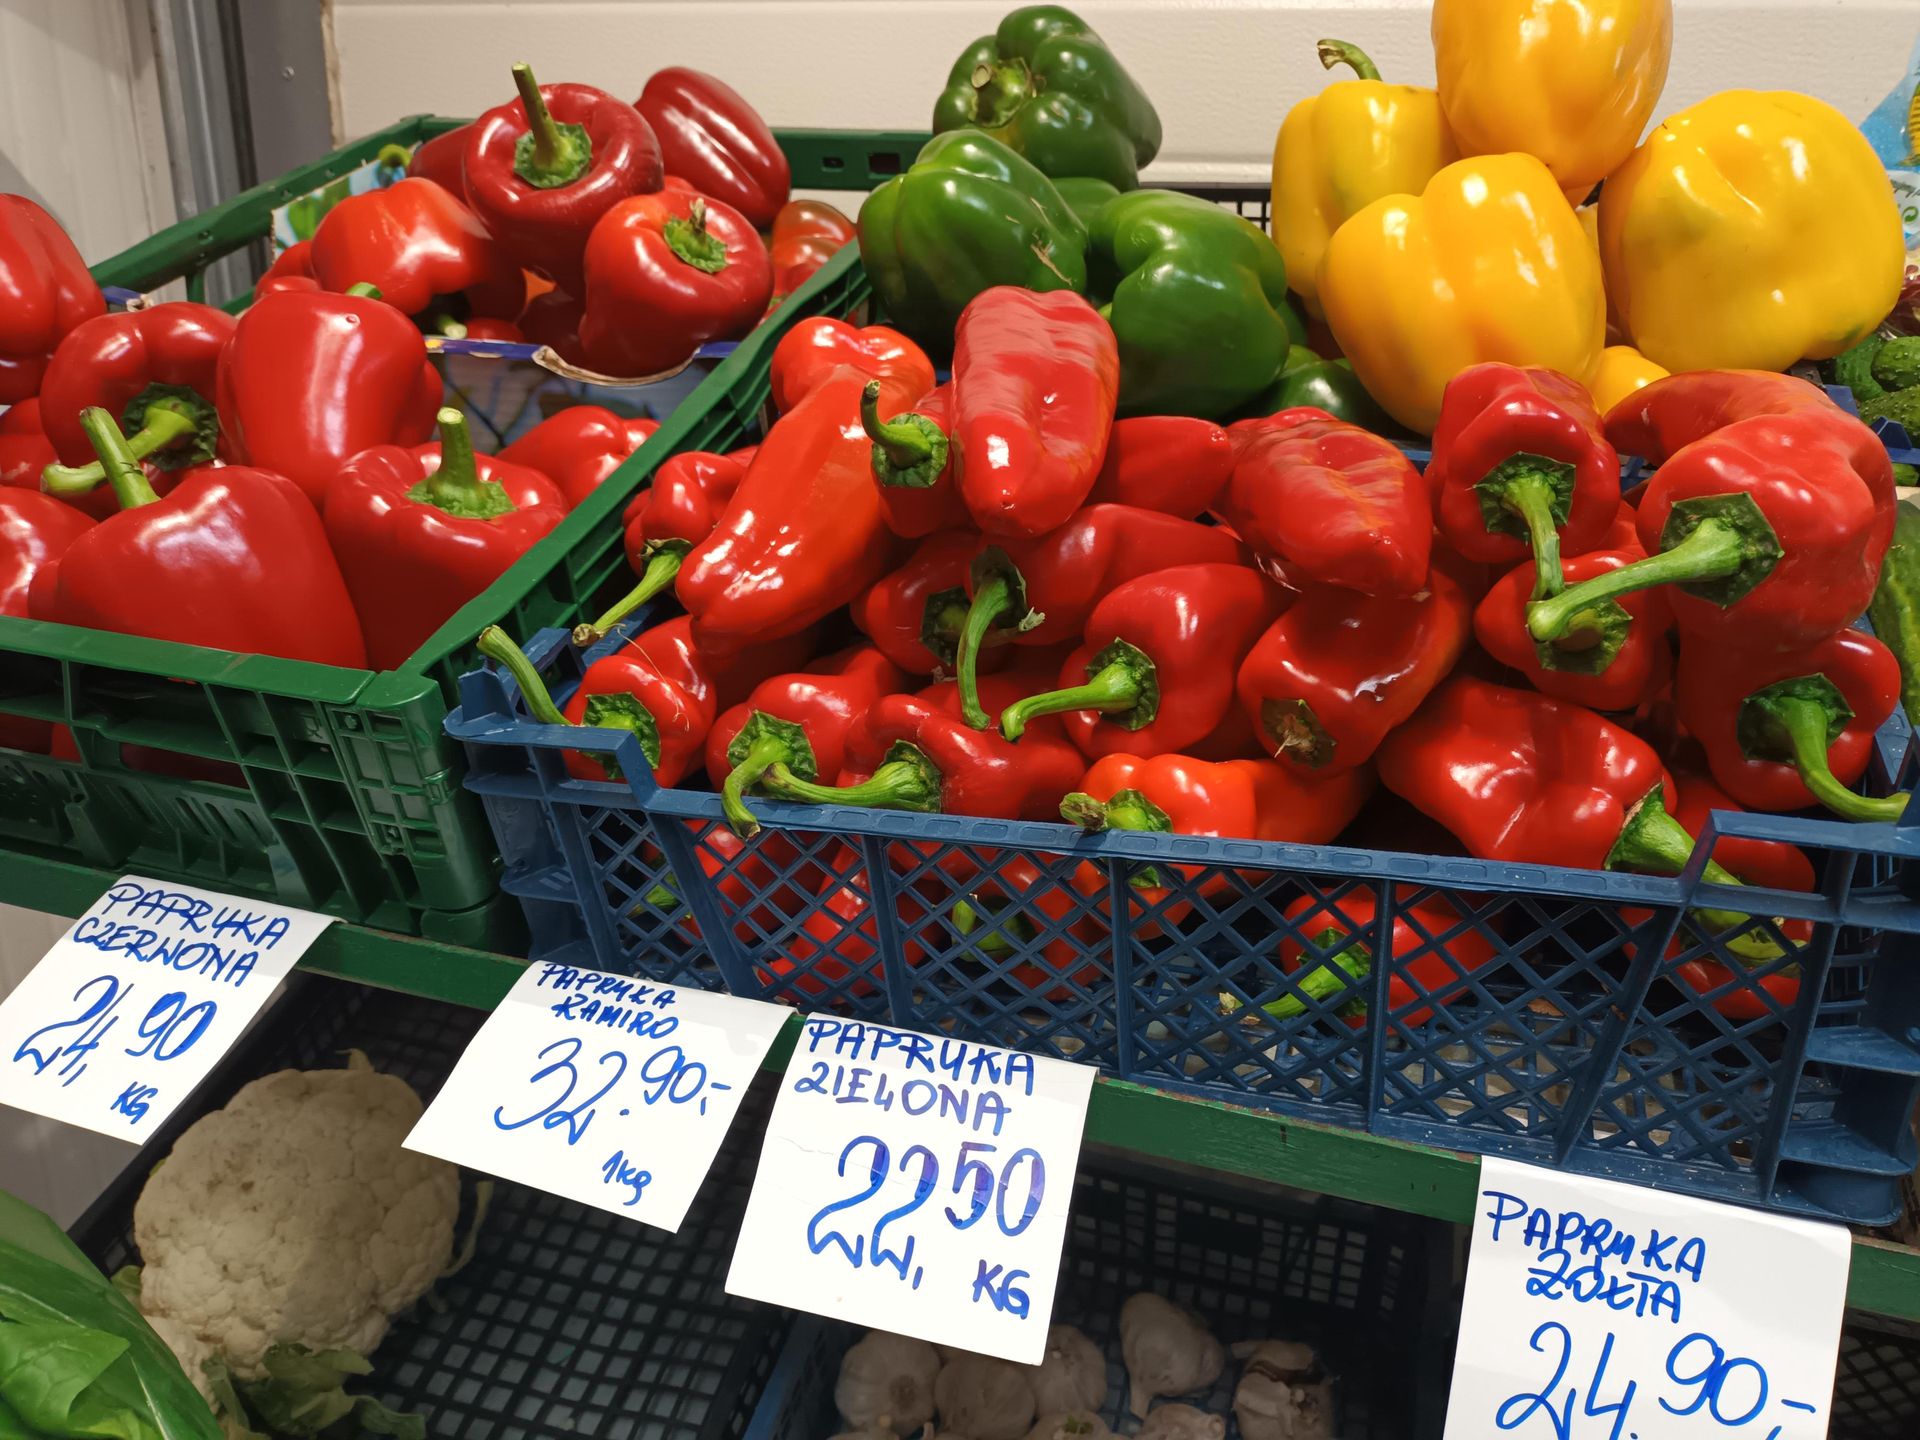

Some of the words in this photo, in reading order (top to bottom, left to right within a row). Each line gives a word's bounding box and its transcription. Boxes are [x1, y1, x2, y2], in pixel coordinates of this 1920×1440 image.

[106, 882, 291, 951] PAPRYKA
[72, 916, 259, 988] CZERWONA
[536, 962, 677, 1010] PAPRYKA
[109, 1081, 159, 1126] KG
[1482, 1190, 1707, 1283] PAPRYKA
[972, 1259, 1031, 1320] KG
